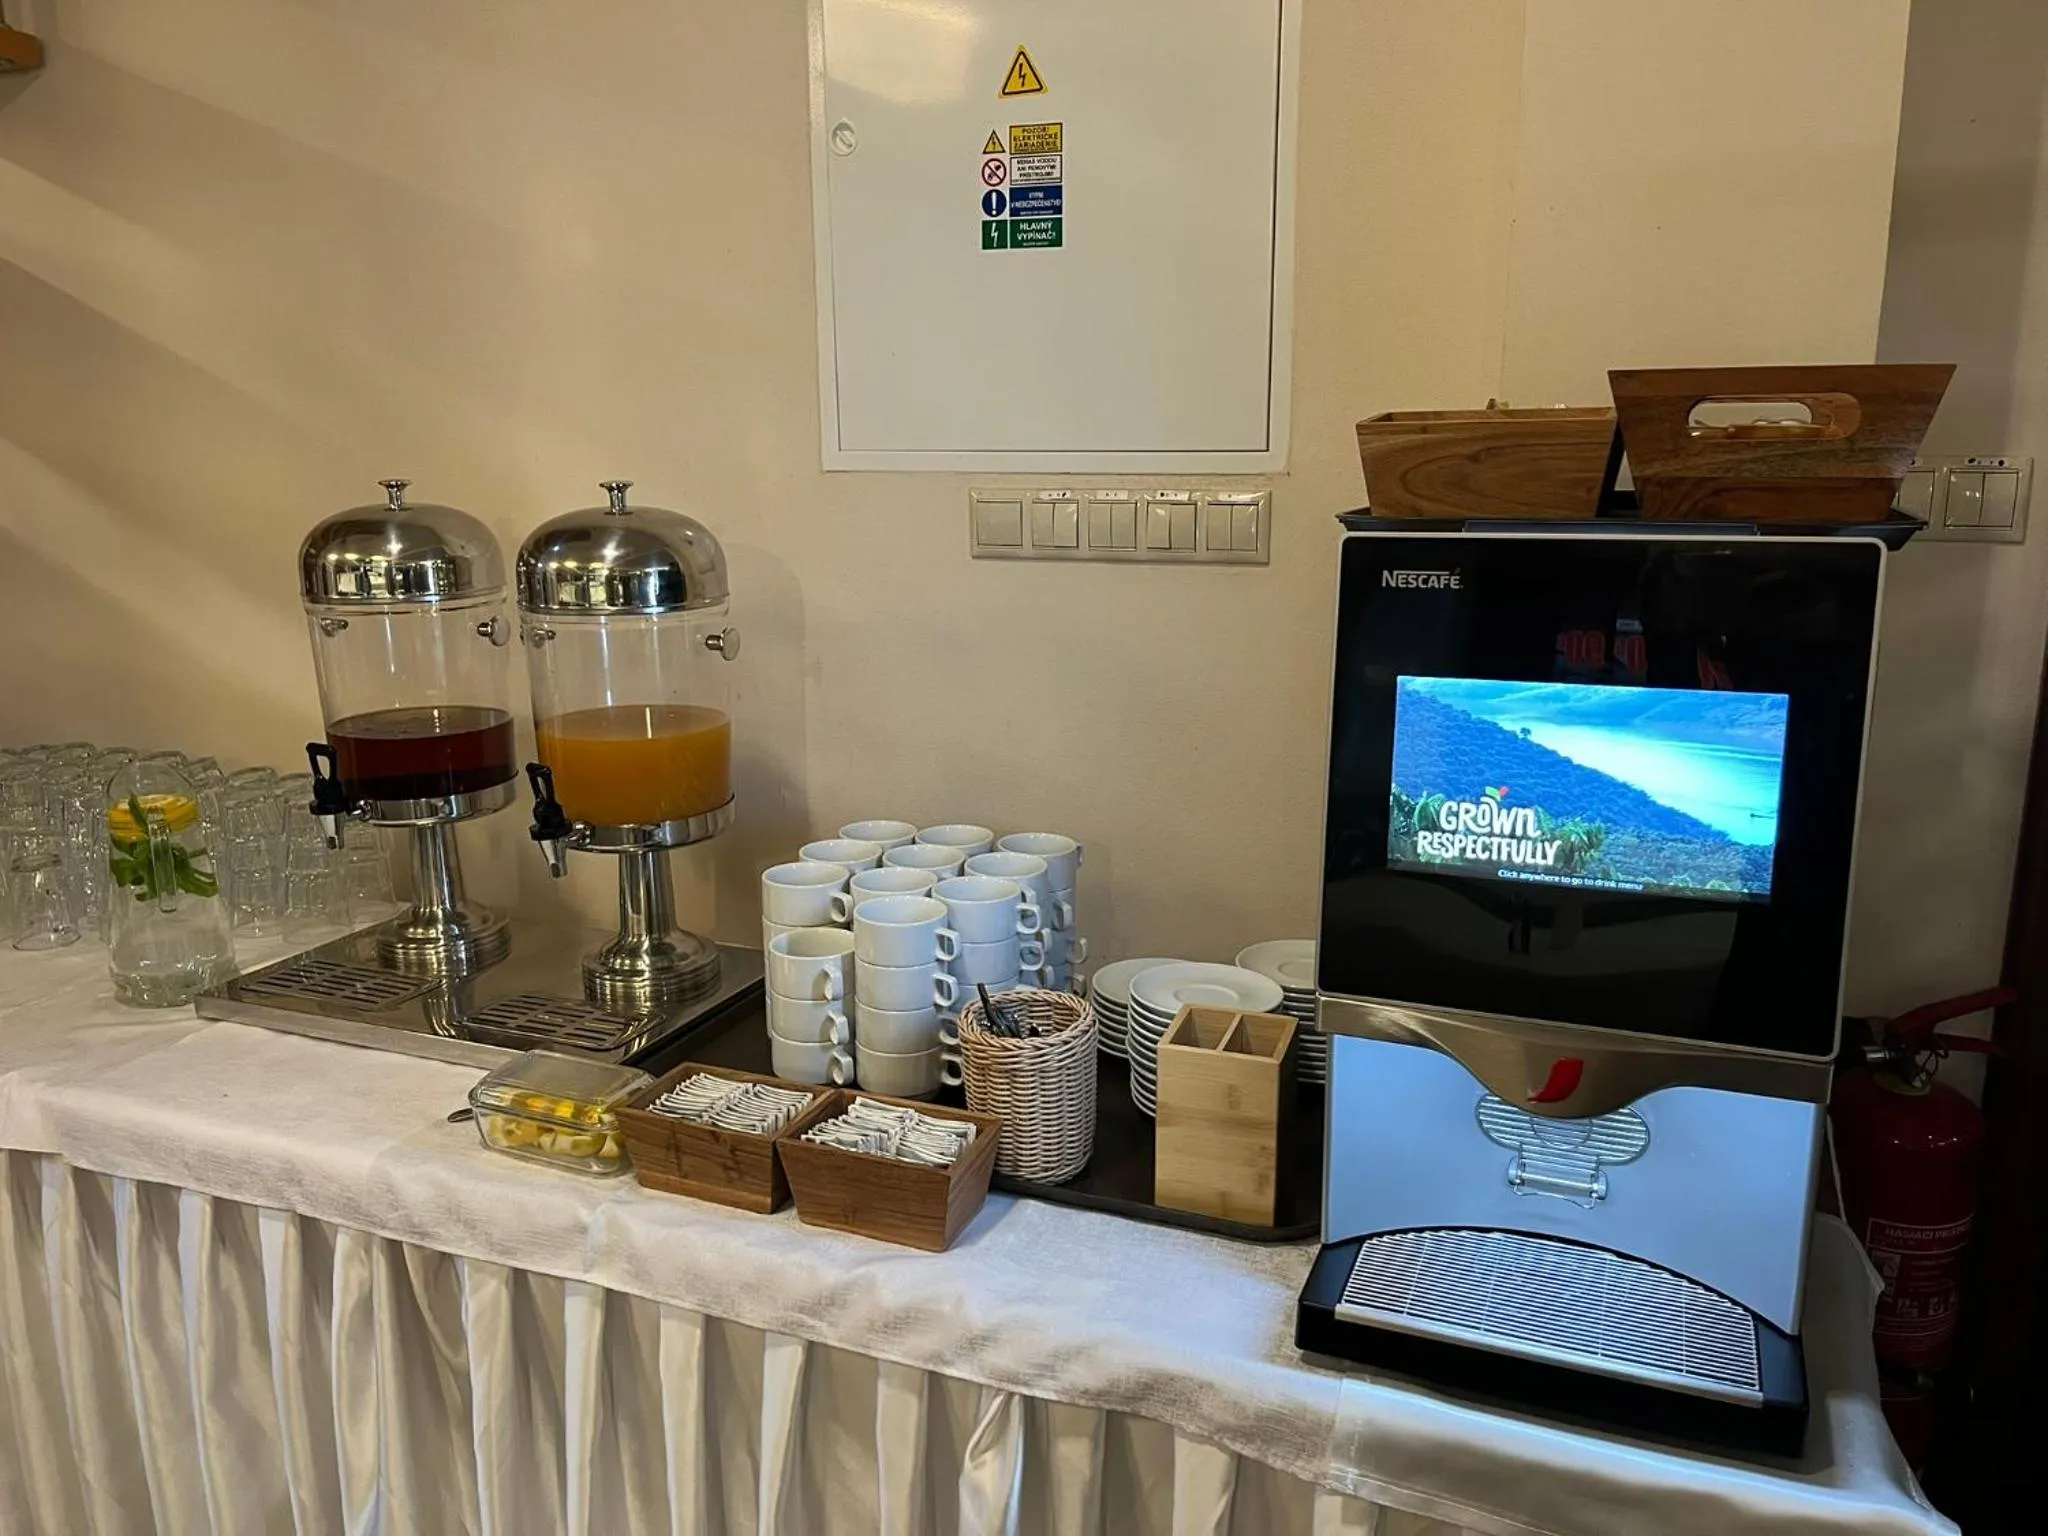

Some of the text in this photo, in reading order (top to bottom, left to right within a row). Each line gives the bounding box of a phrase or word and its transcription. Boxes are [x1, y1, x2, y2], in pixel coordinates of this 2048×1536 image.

[1019, 219, 1053, 230] HLAVNÝ
[1381, 567, 1461, 589] NESCAFÉ
[1416, 830, 1563, 866] RESPECTFULLY
[1497, 868, 1643, 891] Click anywhere to go to drink menu
